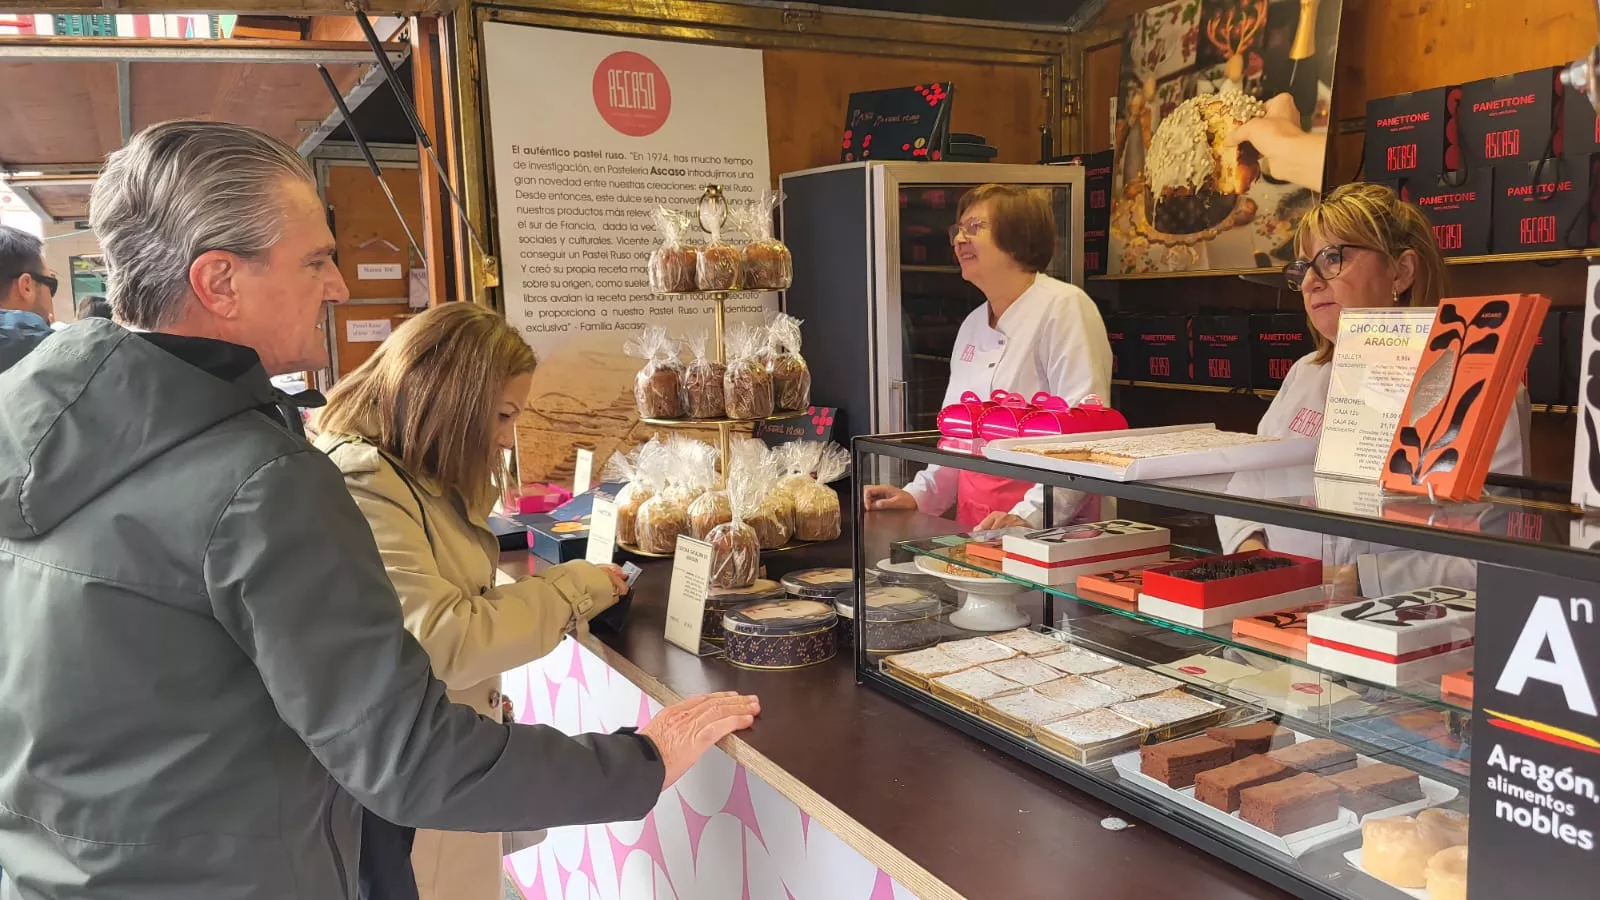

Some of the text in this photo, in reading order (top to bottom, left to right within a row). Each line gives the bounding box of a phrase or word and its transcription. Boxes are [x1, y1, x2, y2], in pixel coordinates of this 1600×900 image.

[607, 69, 656, 110] ASCASO
[1473, 94, 1535, 112] PANETTONE
[1376, 112, 1430, 127] PANETTONE
[1485, 129, 1520, 159] ASCASO
[512, 145, 520, 154] El
[523, 146, 570, 157] auténtico
[573, 149, 602, 159] pastel
[605, 151, 627, 160] ruso.
[647, 153, 670, 162] 1974,
[673, 154, 688, 163] tras
[691, 155, 721, 164] mucho
[723, 156, 753, 166] tiempo
[1387, 144, 1417, 171] ASCASO
[513, 161, 527, 170] de
[528, 161, 591, 174] investigación,
[607, 165, 648, 176] Pastelería
[650, 166, 686, 176] Ascaso
[687, 169, 736, 179] introdujimos
[738, 171, 754, 179] una
[514, 176, 537, 186] gran
[538, 177, 582, 187] novedad
[583, 179, 607, 188] entre
[609, 180, 645, 190] nuestras
[646, 181, 697, 191] creaciones:
[733, 183, 755, 193] Ruso.
[515, 190, 546, 200] Desde
[548, 191, 594, 202] entonces,
[596, 193, 615, 202] este
[616, 193, 642, 203] dulce
[655, 195, 667, 204] ha
[1419, 192, 1476, 205] PANETTONE
[516, 206, 555, 216] nuestros
[557, 207, 603, 217] productos
[605, 207, 624, 217] más
[518, 220, 526, 229] el
[529, 221, 542, 230] sur
[545, 220, 558, 230] de
[560, 220, 597, 231] Francia,
[602, 222, 628, 231] dada
[629, 223, 639, 232] la
[1520, 215, 1556, 244] ASCASO
[518, 234, 557, 245] sociales
[560, 236, 566, 246] y
[568, 235, 613, 246] culturales.
[616, 236, 650, 246] Vicente
[520, 250, 566, 262] conseguir
[569, 251, 580, 259] un
[582, 250, 608, 260] Pastel
[610, 250, 632, 260] Ruso
[521, 264, 527, 273] Y
[529, 264, 551, 274] creó
[553, 266, 564, 274] su
[566, 264, 596, 275] propia
[598, 264, 628, 274] receta
[522, 280, 549, 289] sobre
[550, 281, 561, 289] su
[562, 280, 594, 290] origen,
[595, 280, 623, 289] como
[523, 293, 548, 303] libros
[550, 294, 582, 303] avalan
[585, 293, 594, 303] la
[596, 292, 627, 303] receta
[524, 308, 533, 318] le
[538, 308, 596, 319] proporciona
[612, 307, 645, 317] nuestro
[649, 306, 674, 316] Pastel
[678, 306, 699, 315] Ruso
[580, 320, 612, 331] Familia
[1350, 324, 1430, 334] CHOCOLATE DE
[1260, 333, 1303, 341] PANETTONE
[1364, 335, 1409, 347] ARAGÓN
[1269, 358, 1293, 379] ASCAS
[1495, 595, 1598, 717] An
[1487, 744, 1600, 804] Aragón,
[1487, 774, 1575, 817] alimentos
[1495, 799, 1594, 850] nobles
